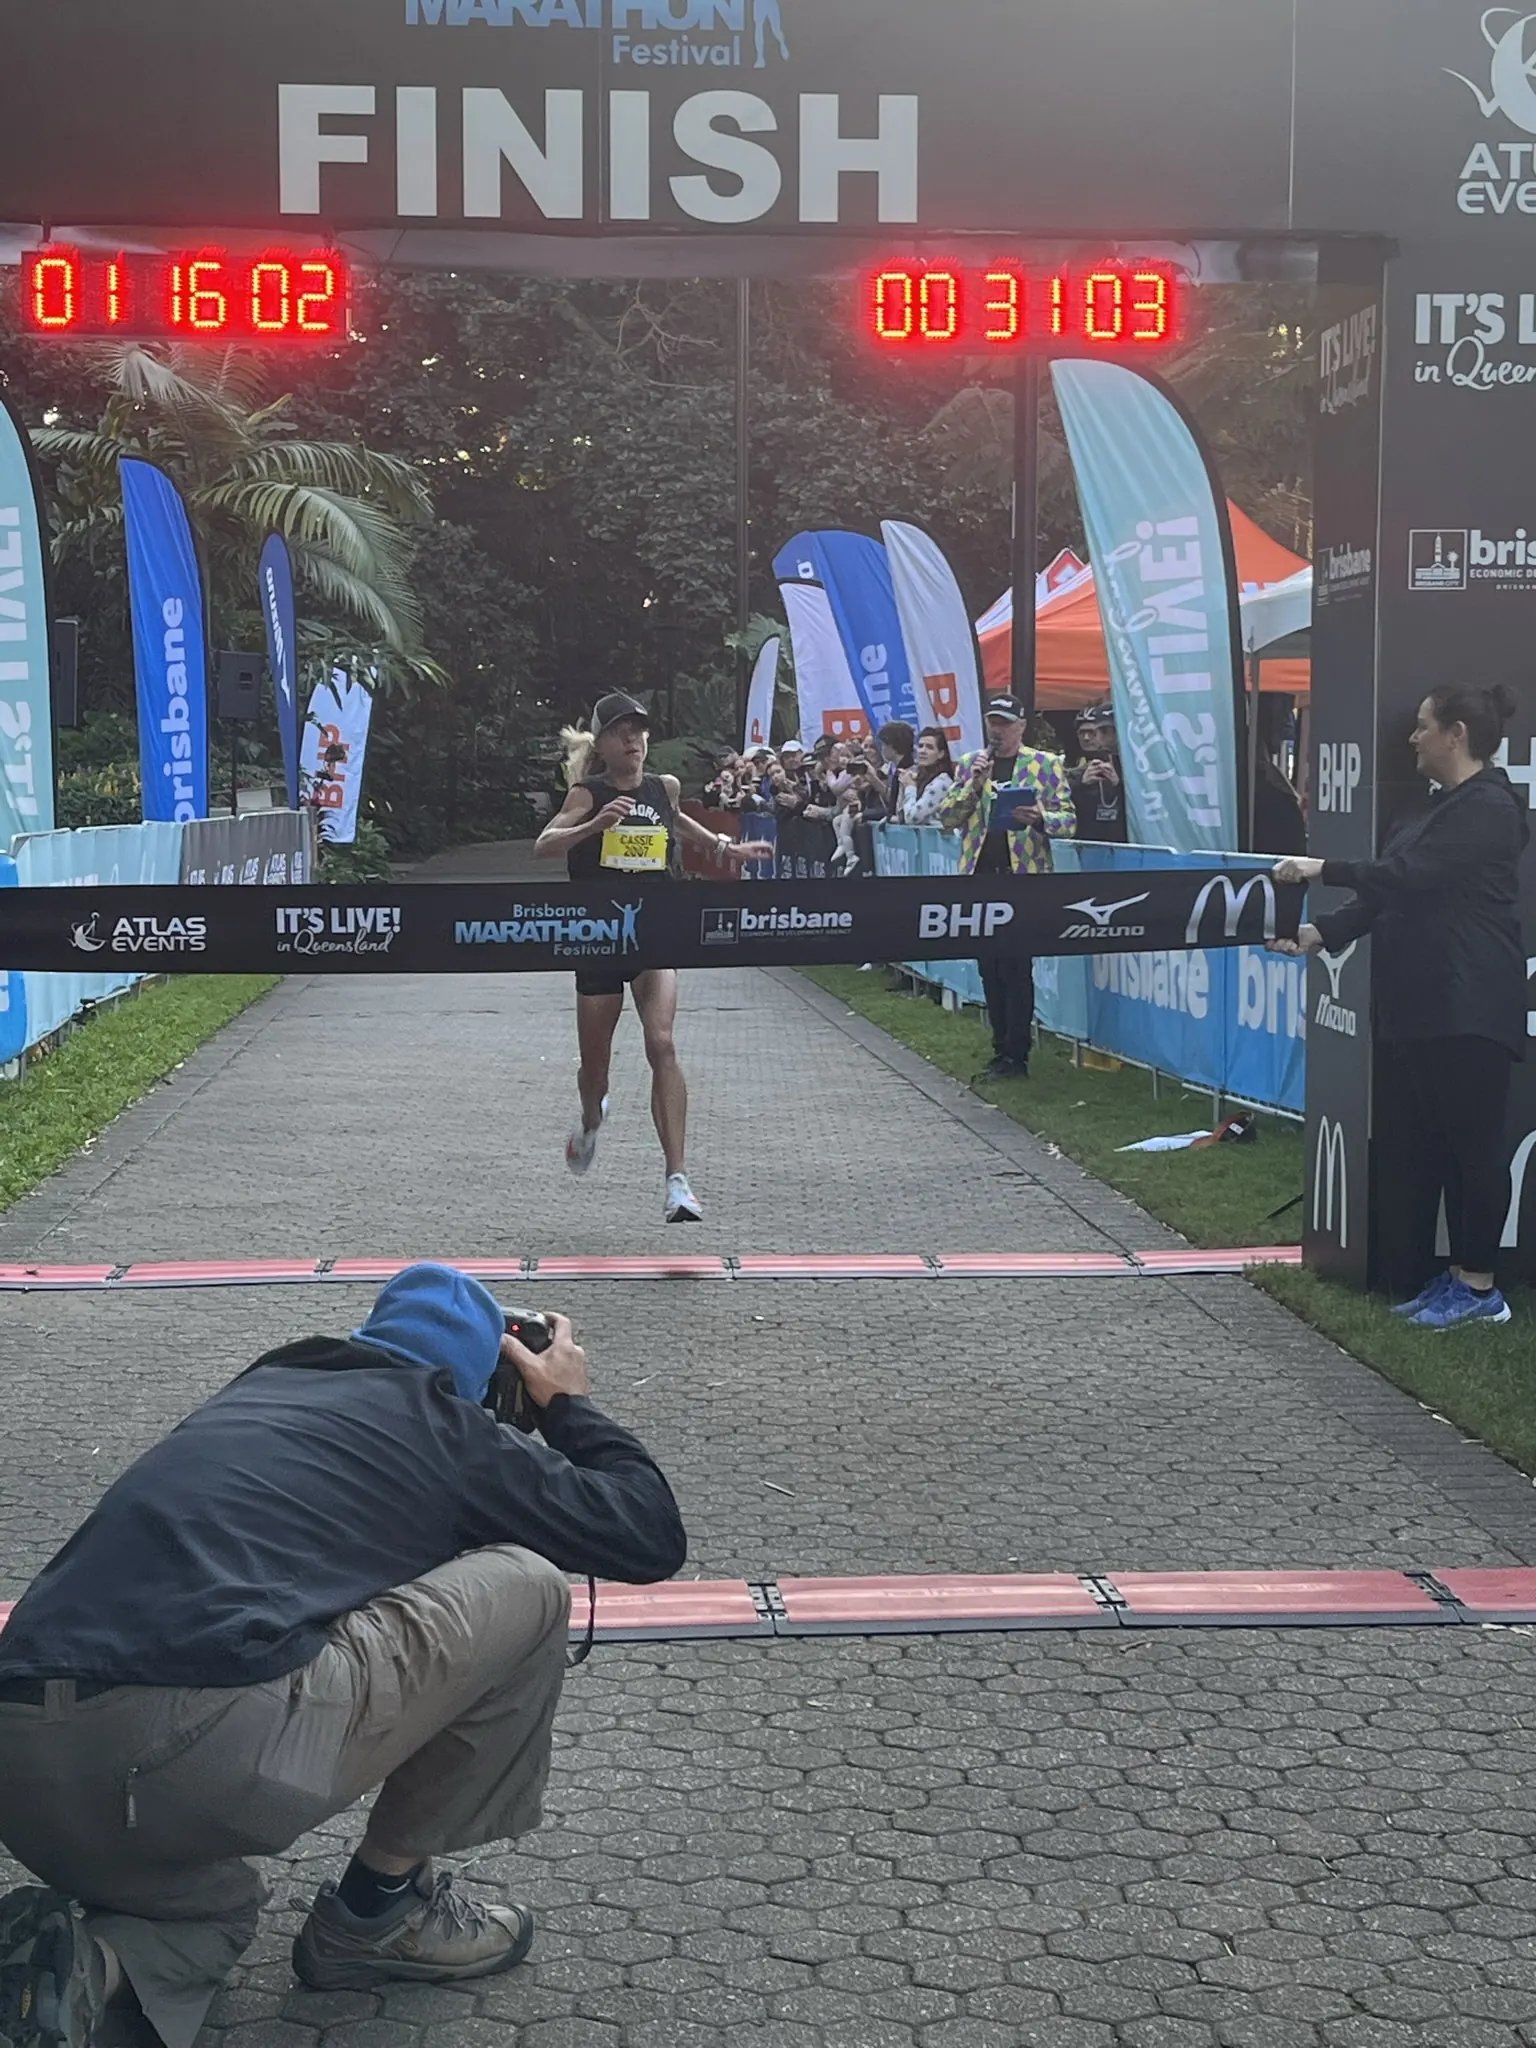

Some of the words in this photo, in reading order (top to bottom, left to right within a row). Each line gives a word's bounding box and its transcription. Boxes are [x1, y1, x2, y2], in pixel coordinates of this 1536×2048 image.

[612, 33, 742, 67] Festival
[278, 83, 920, 224] FINISH
[1459, 142, 1536, 180] AT
[35, 257, 119, 326] 01
[173, 260, 226, 329] 16
[252, 262, 332, 331] 02
[875, 272, 956, 339] 00
[985, 272, 1061, 339] 31
[1085, 273, 1166, 339] 03
[1415, 293, 1505, 345] IT'S
[1414, 360, 1441, 384] in
[1470, 568, 1524, 579] ECONOMIC
[1317, 743, 1361, 813] BHP
[276, 907, 324, 934] IT'S
[331, 906, 401, 934] LIVE!
[512, 902, 587, 918] Brisbane
[740, 906, 853, 930] brisbane
[918, 902, 1015, 939] BHP
[112, 917, 207, 937] ATLAS
[277, 941, 291, 953] in
[293, 925, 394, 955] Queensland
[454, 919, 619, 944] MARATHON
[111, 936, 206, 952] EVENTS
[553, 942, 616, 957] Festival
